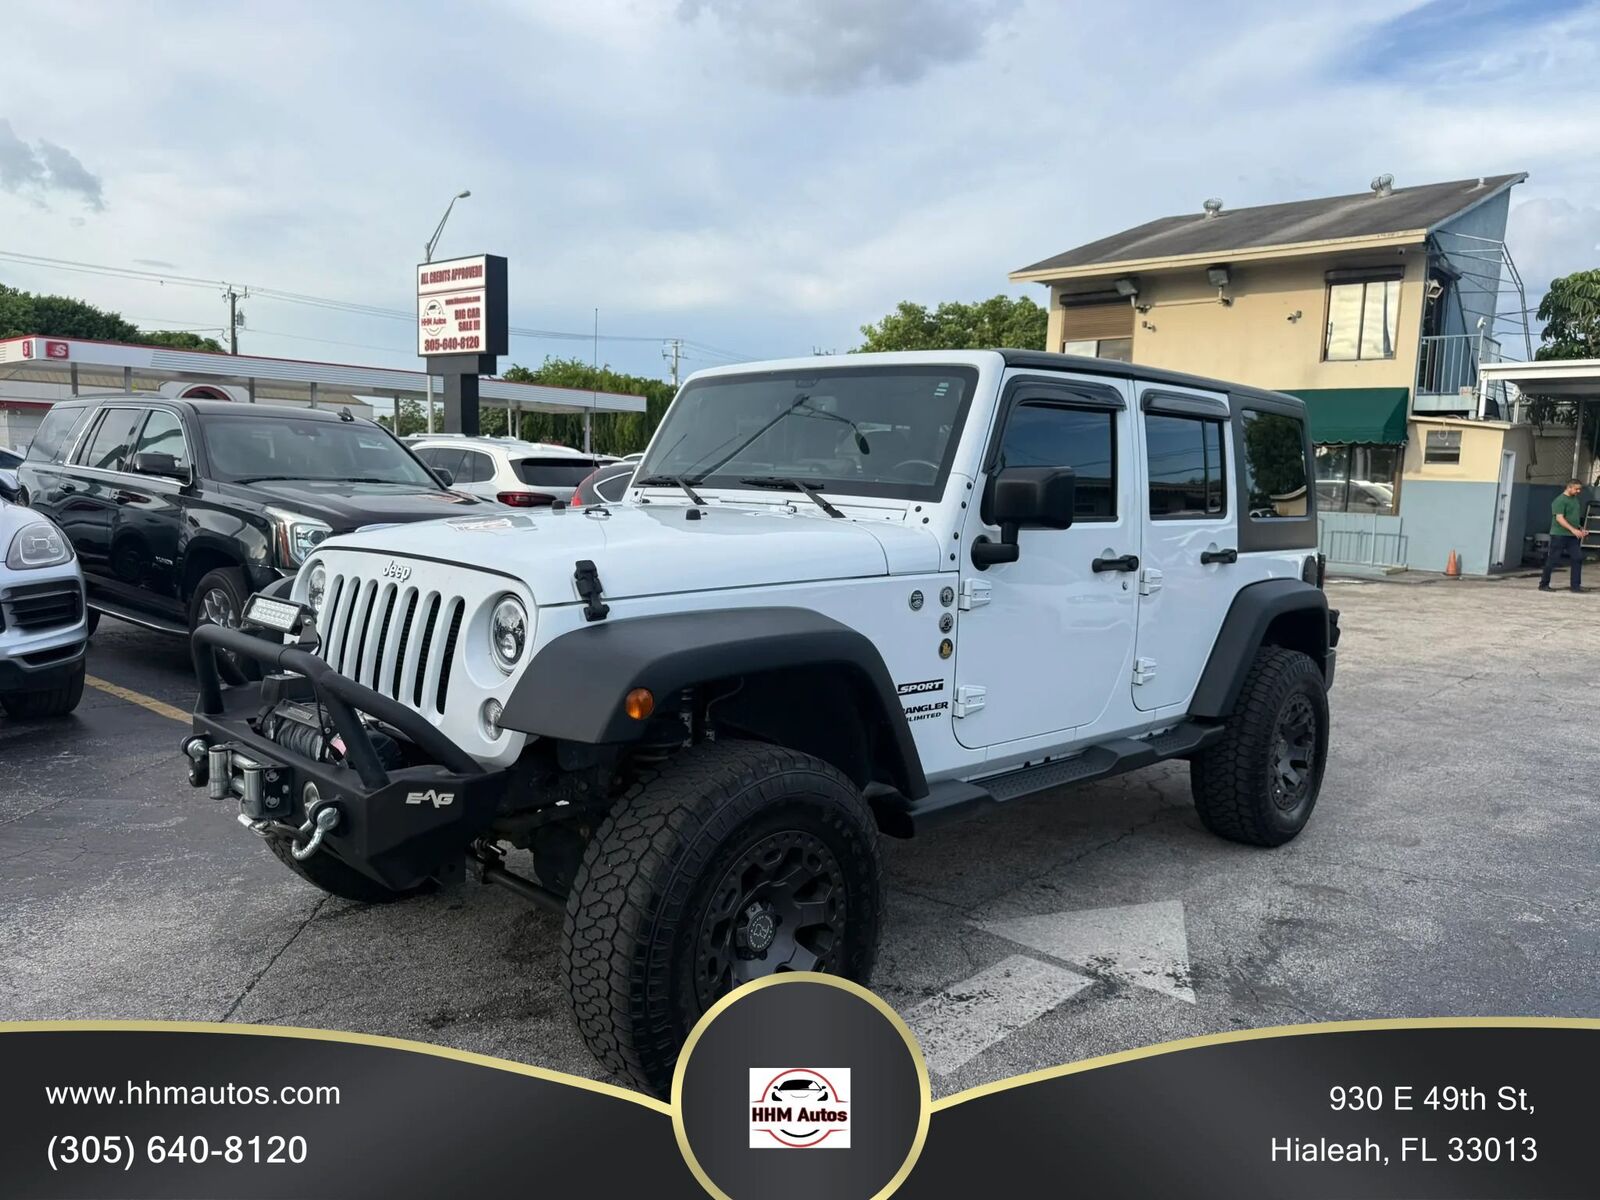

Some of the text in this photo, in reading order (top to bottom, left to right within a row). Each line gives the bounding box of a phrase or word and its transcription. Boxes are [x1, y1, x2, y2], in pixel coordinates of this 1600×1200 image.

[421, 272, 429, 285] ALL
[430, 269, 451, 284] CREDITS
[454, 307, 481, 320] BIG CAR
[458, 321, 473, 332] SALE
[424, 336, 480, 351] 305-640-8120
[383, 559, 412, 583] Jeep
[898, 681, 944, 694] SPORT
[903, 701, 949, 714] ANGLER
[906, 712, 942, 722] LIMITED
[405, 789, 455, 808] EAG
